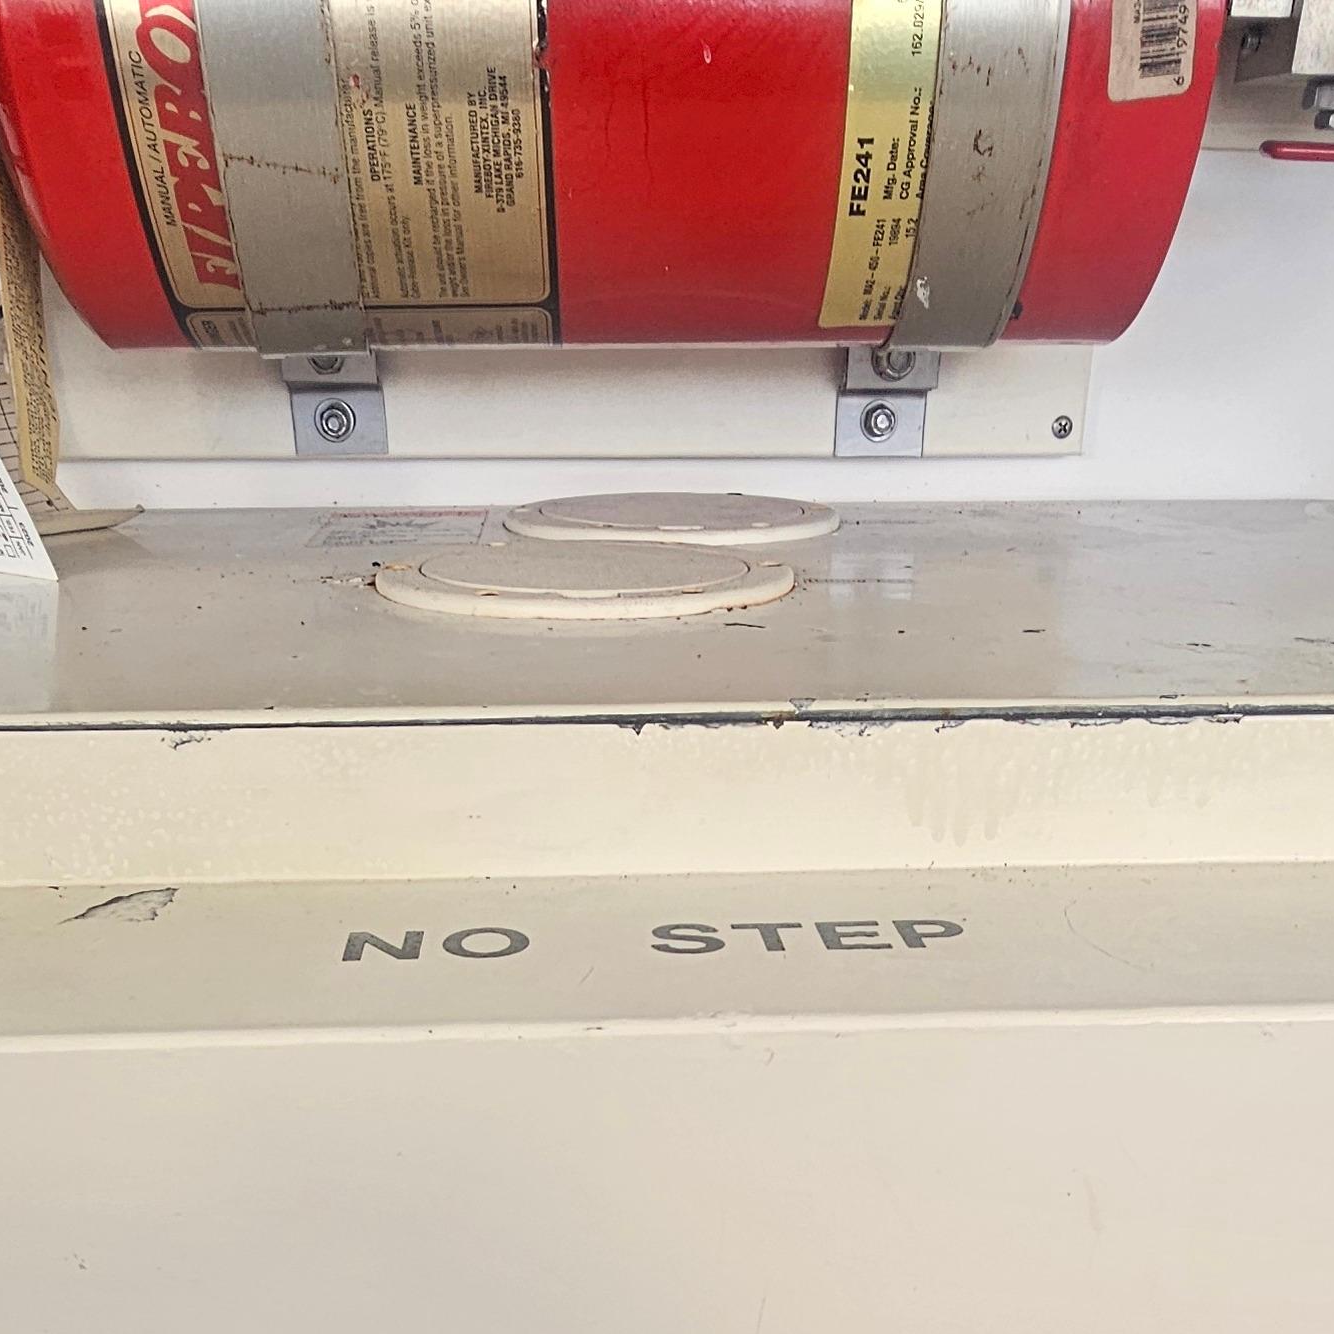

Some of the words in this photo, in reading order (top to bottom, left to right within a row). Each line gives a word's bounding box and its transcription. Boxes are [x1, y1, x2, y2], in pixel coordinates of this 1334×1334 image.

[366, 20, 380, 62] release
[424, 15, 434, 38] unit
[413, 34, 425, 81] exceeds
[372, 65, 384, 107] Manual
[468, 92, 476, 106] BY
[479, 87, 488, 109] INC.
[488, 66, 498, 101] DRIVE
[500, 75, 508, 109] 49544
[129, 50, 159, 153] AUTOMATIC
[417, 84, 429, 121] weight
[502, 112, 509, 125] MI
[910, 87, 922, 116] No.:
[364, 108, 380, 181] OPERATIONS
[406, 103, 423, 186] MAINTENANCE
[421, 124, 429, 134] in
[491, 105, 501, 158] MICHIGAN
[422, 137, 432, 158] loss
[434, 151, 444, 161] of
[469, 110, 483, 193] MANUFACTURED
[887, 137, 899, 171] Date:
[903, 119, 919, 178] Approval
[424, 161, 434, 177] the
[494, 161, 503, 185] LAKE
[849, 137, 874, 216] FE241
[153, 166, 177, 226] MANUAL
[505, 173, 515, 207] GRAND
[882, 174, 897, 200] Mfg.
[899, 181, 911, 200] CG
[341, 926, 530, 962] NO
[650, 920, 965, 955] STEP
